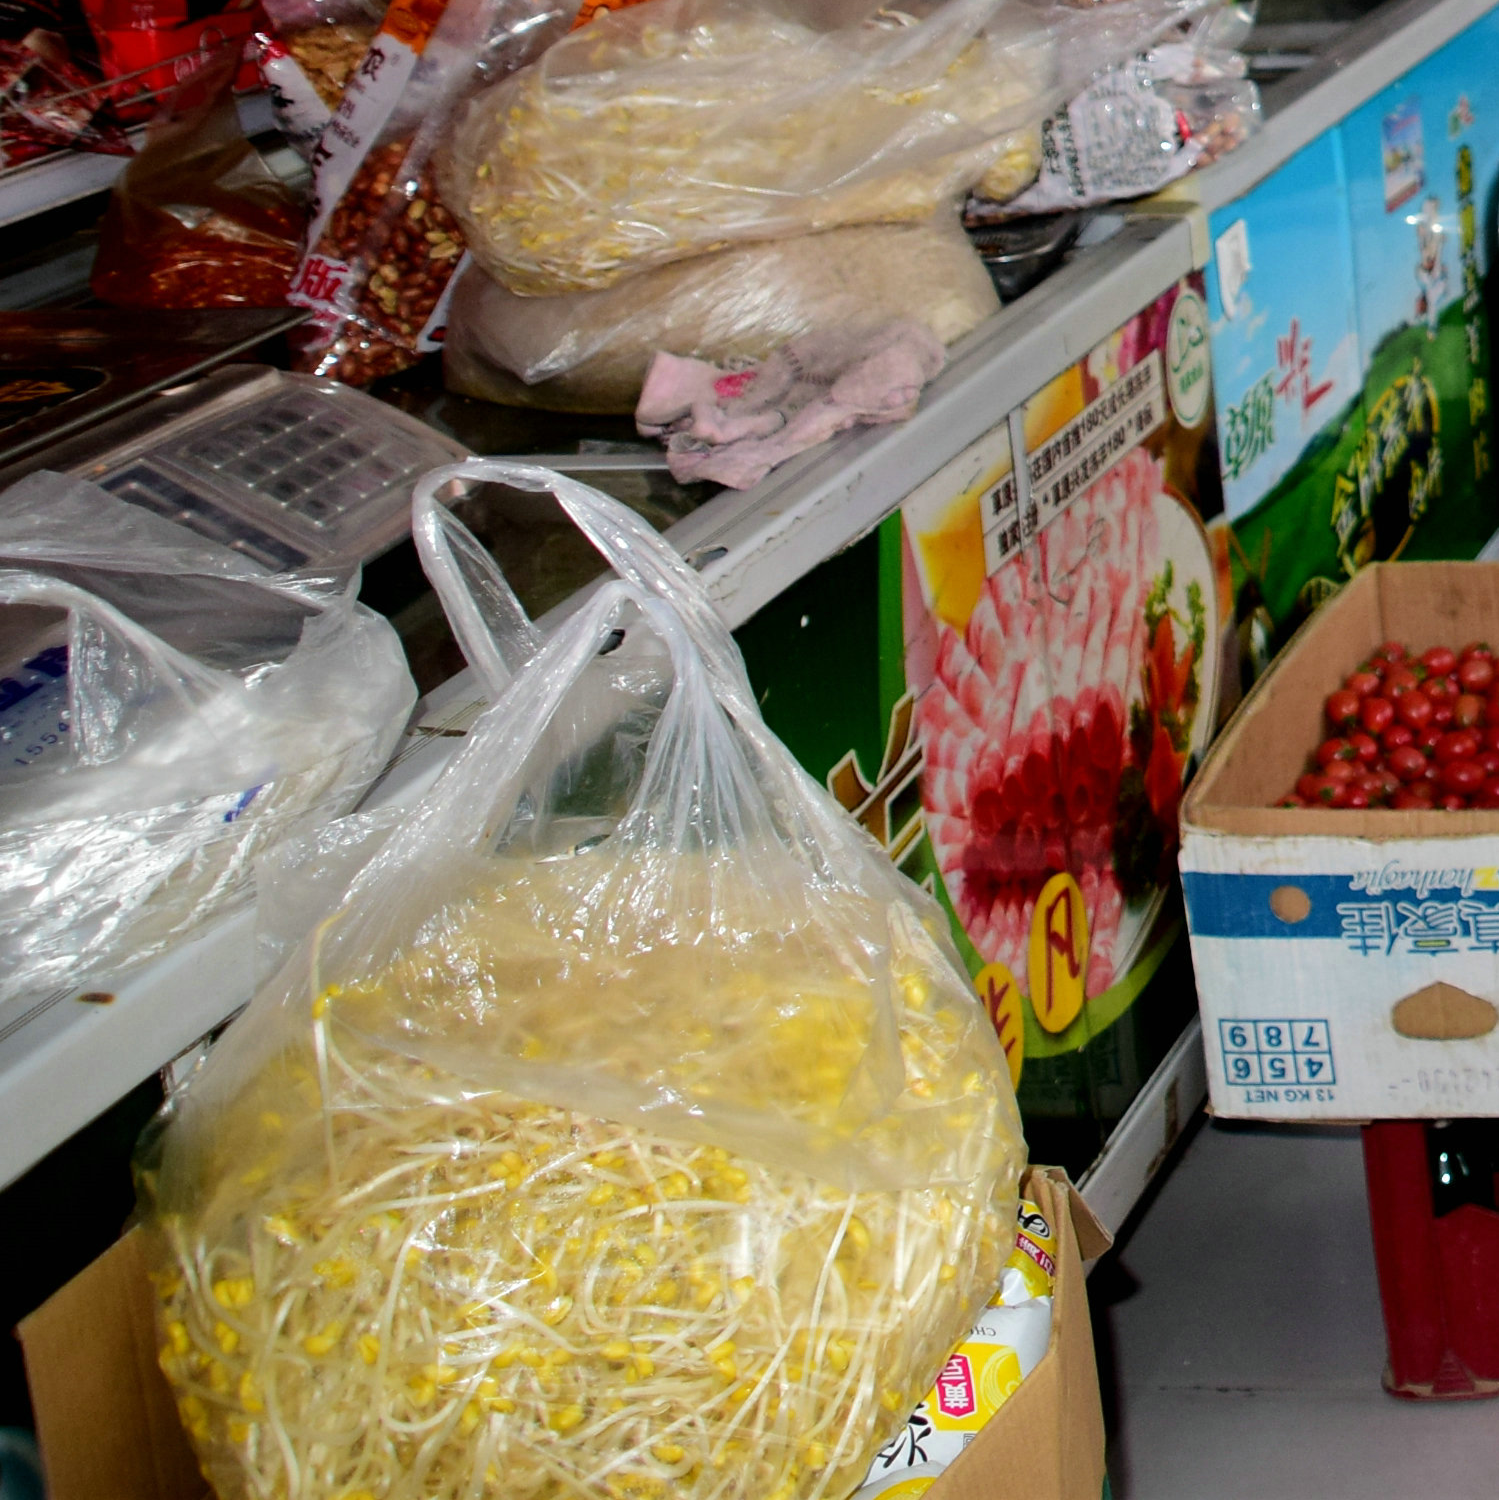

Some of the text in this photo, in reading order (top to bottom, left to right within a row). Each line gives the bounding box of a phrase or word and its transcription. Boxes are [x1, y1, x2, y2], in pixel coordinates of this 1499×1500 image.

[1229, 1026, 1319, 1048] 7 8 9
[1232, 1057, 1325, 1079] 4 5 6
[1243, 1088, 1334, 1104] 13 KG NET
[941, 1357, 971, 1411] 黄豆
